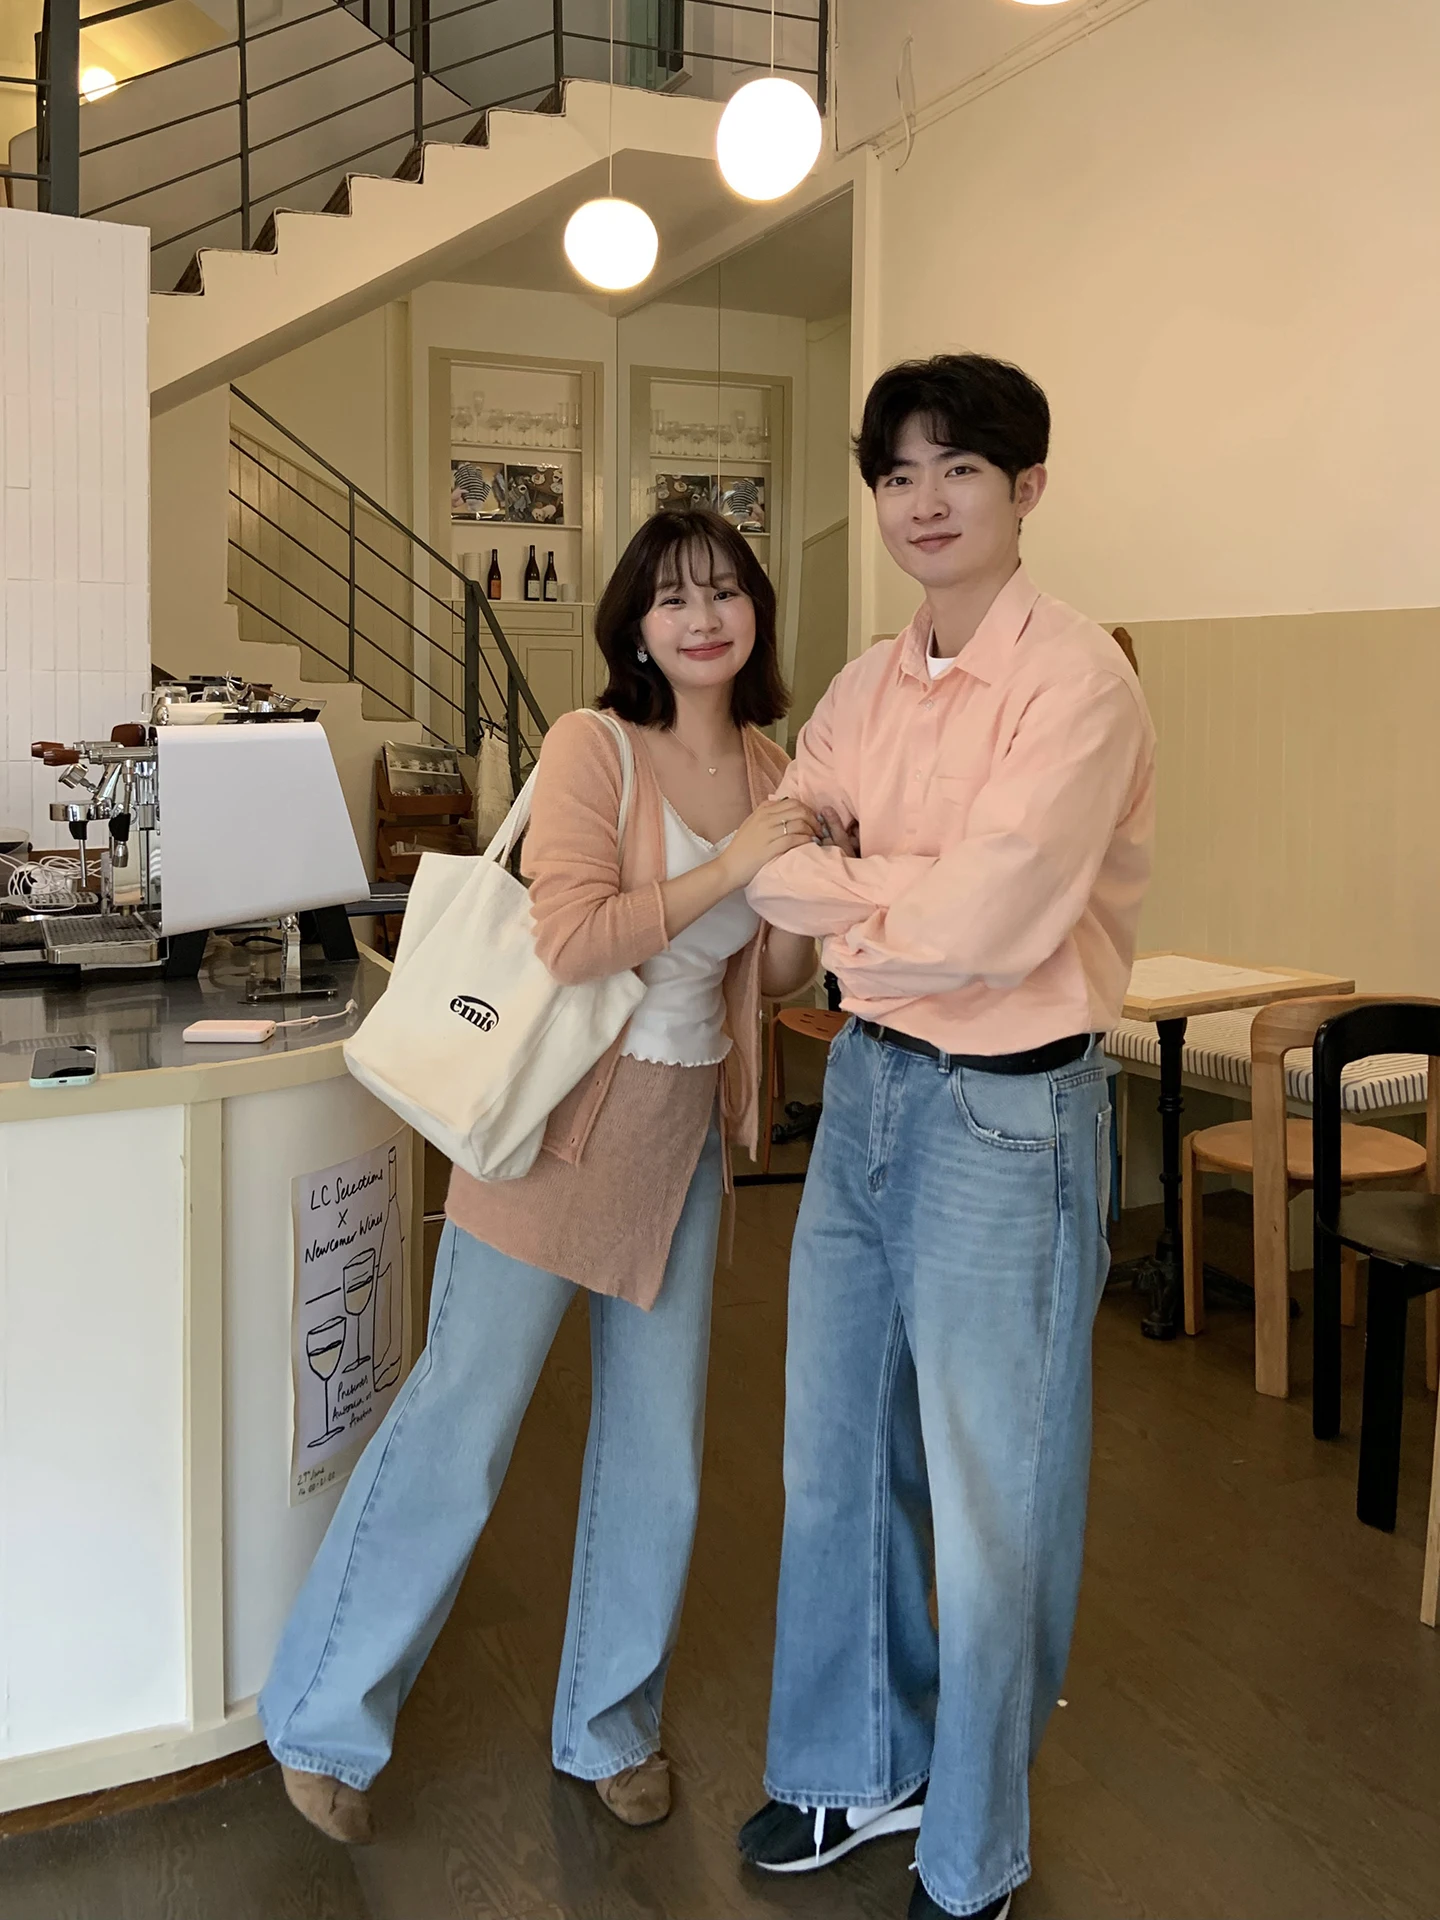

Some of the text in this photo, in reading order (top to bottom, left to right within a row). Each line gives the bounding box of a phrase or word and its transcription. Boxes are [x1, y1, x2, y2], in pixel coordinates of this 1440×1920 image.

[450, 998, 495, 1033] emis
[311, 1169, 383, 1210] LC Selections
[305, 1212, 383, 1263] Newcomer Wines
